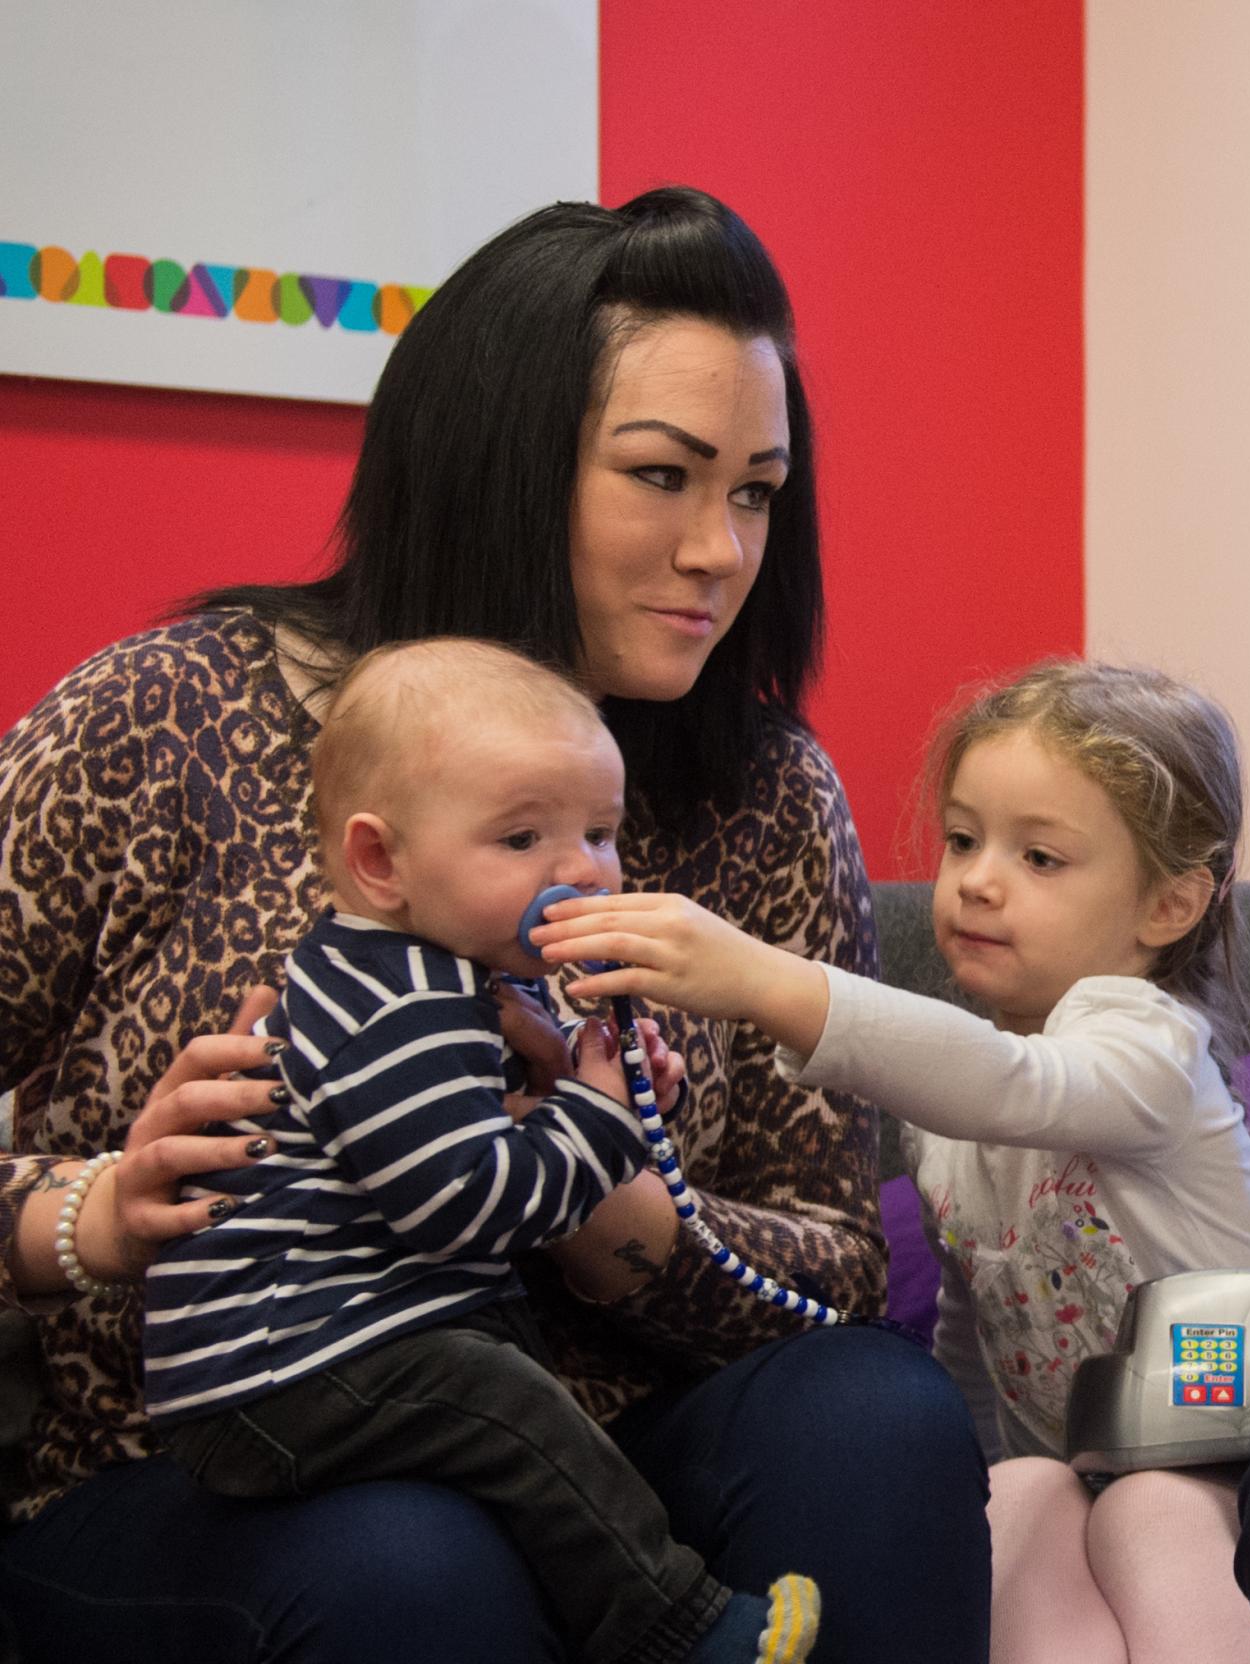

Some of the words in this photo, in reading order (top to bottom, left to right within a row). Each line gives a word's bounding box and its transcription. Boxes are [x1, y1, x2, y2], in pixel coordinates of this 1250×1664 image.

[1186, 1328, 1215, 1336] Enter
[1218, 1328, 1236, 1337] Pin
[1204, 1374, 1235, 1383] Enter
